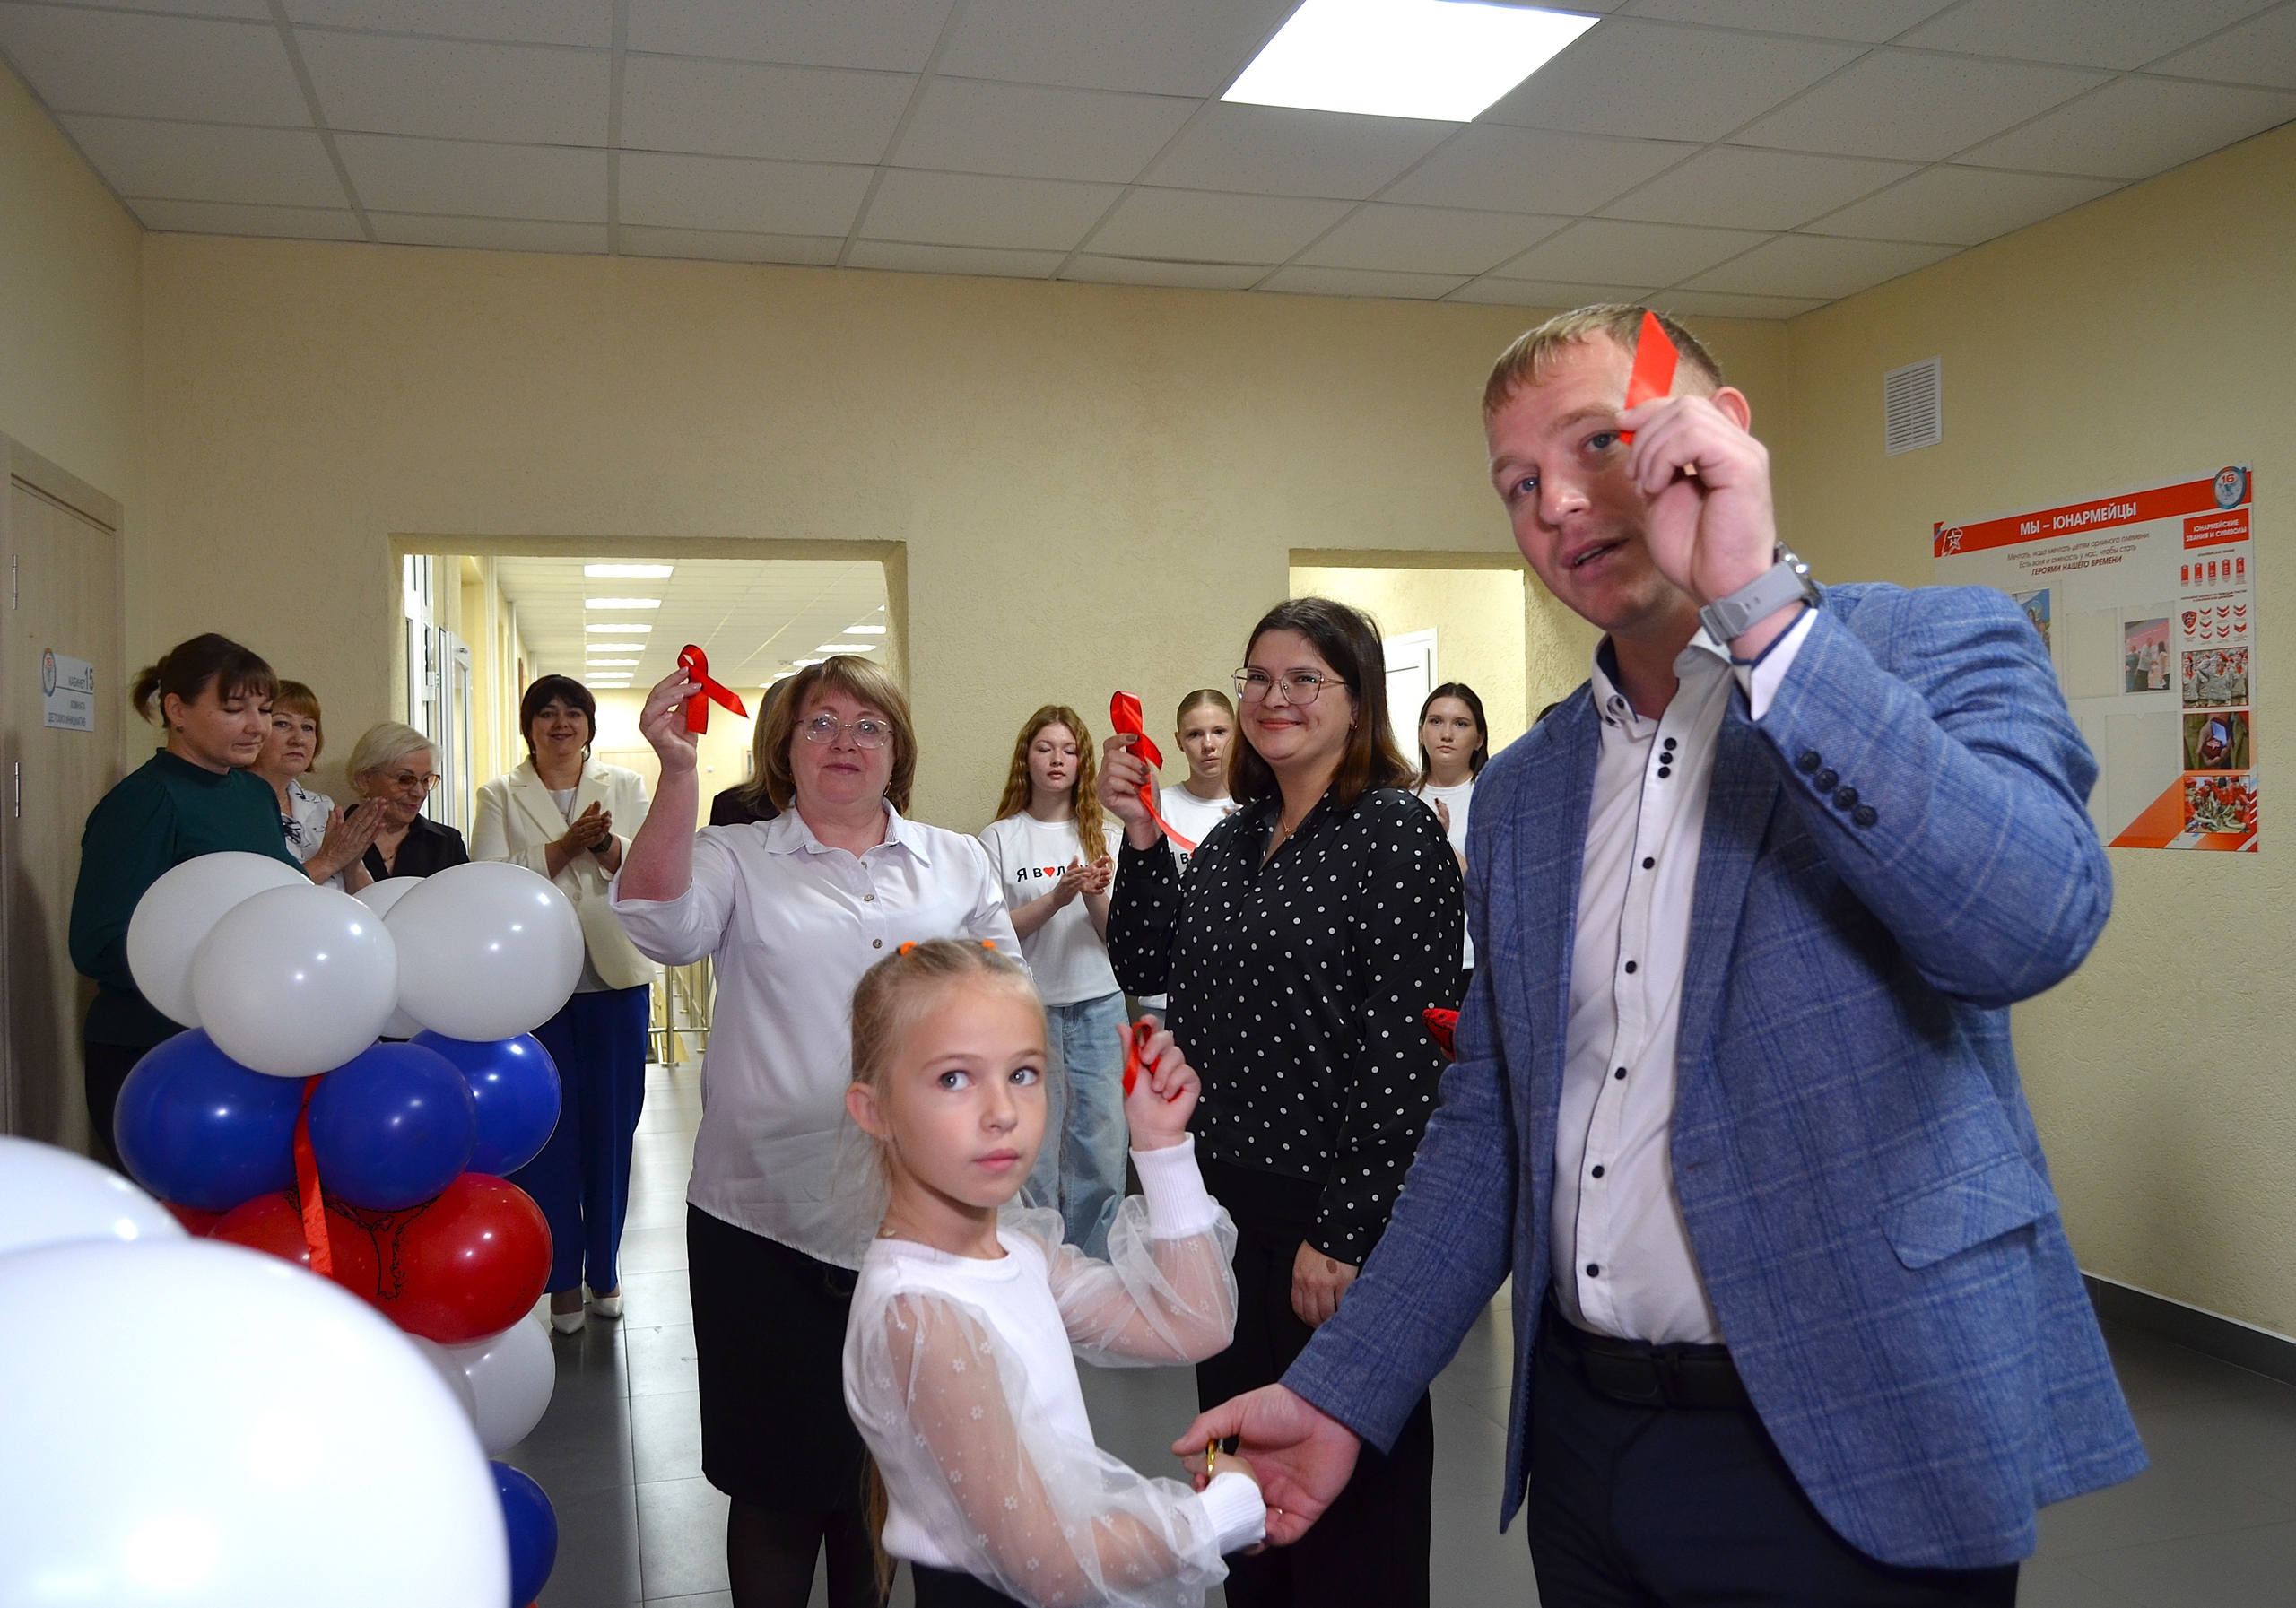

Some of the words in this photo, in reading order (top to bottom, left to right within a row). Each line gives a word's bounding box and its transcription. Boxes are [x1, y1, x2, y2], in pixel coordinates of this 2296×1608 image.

[2222, 474, 2235, 483] 16
[2020, 520, 2039, 535] МЫ
[2053, 502, 2136, 530] ЮНАРМЕЙЦЫ
[2194, 519, 2239, 532] ЮНАРМЕЙСКИЕ
[2187, 533, 2208, 542] ЗВАНИЯ
[2215, 526, 2247, 536] СИМВОЛЫ
[2091, 537, 2119, 548] орлиного
[2100, 546, 2118, 556] чтобы
[2031, 566, 2061, 576] ГЕРОЯМИ
[2063, 561, 2090, 571] НАШЕГО
[2091, 555, 2122, 567] ВРЕМЕНИ
[85, 666, 94, 691] 15
[1016, 867, 1028, 882] Я
